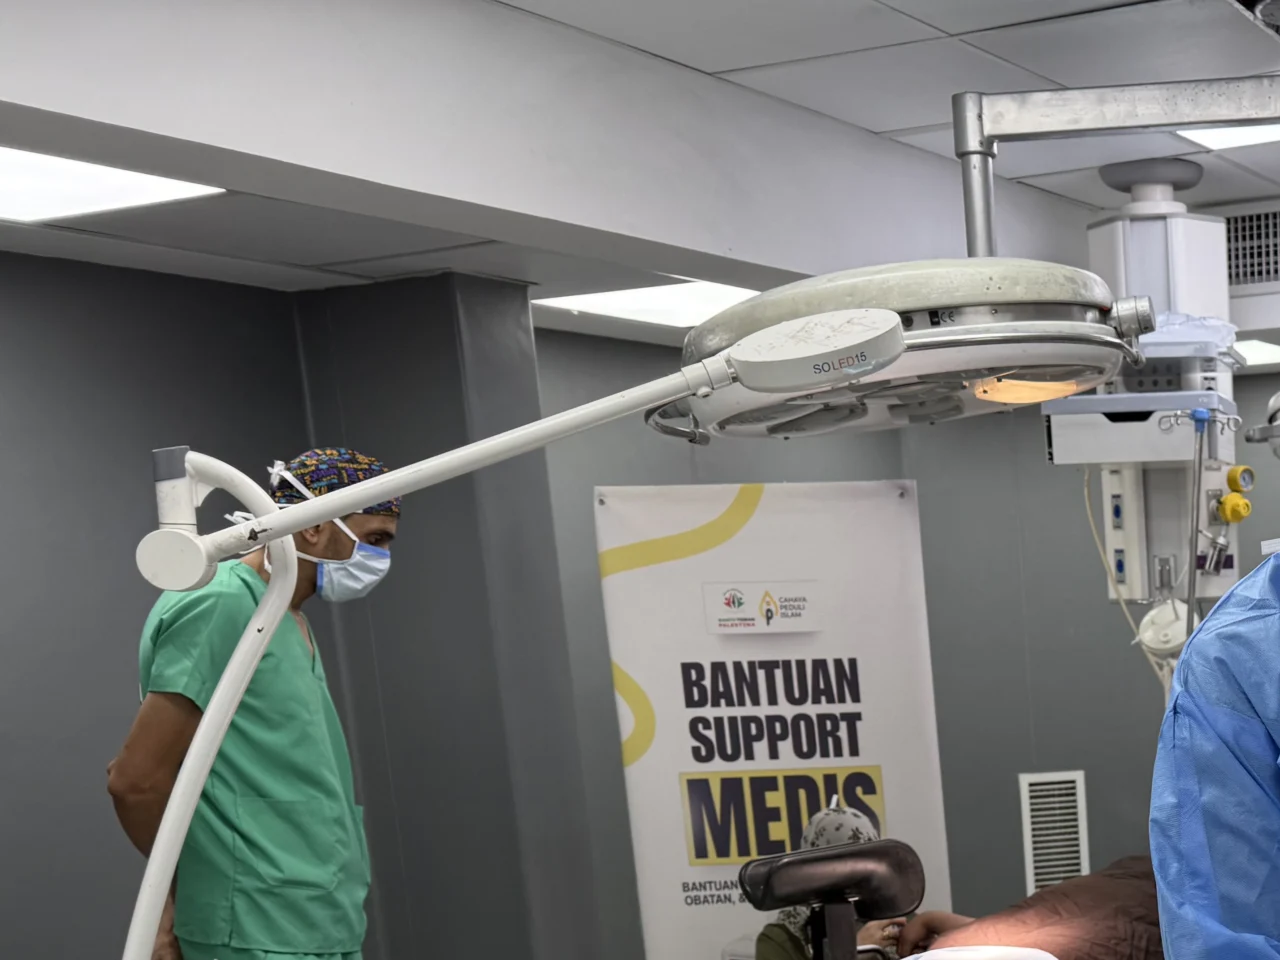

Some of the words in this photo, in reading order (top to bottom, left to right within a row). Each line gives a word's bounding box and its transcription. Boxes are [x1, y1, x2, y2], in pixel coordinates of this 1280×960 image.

[813, 351, 867, 374] SOLED15
[680, 657, 861, 708] BANTUAN
[688, 712, 862, 763] SUPPORT
[682, 880, 739, 892] BANTUAN
[685, 893, 736, 906] OBATAN,
